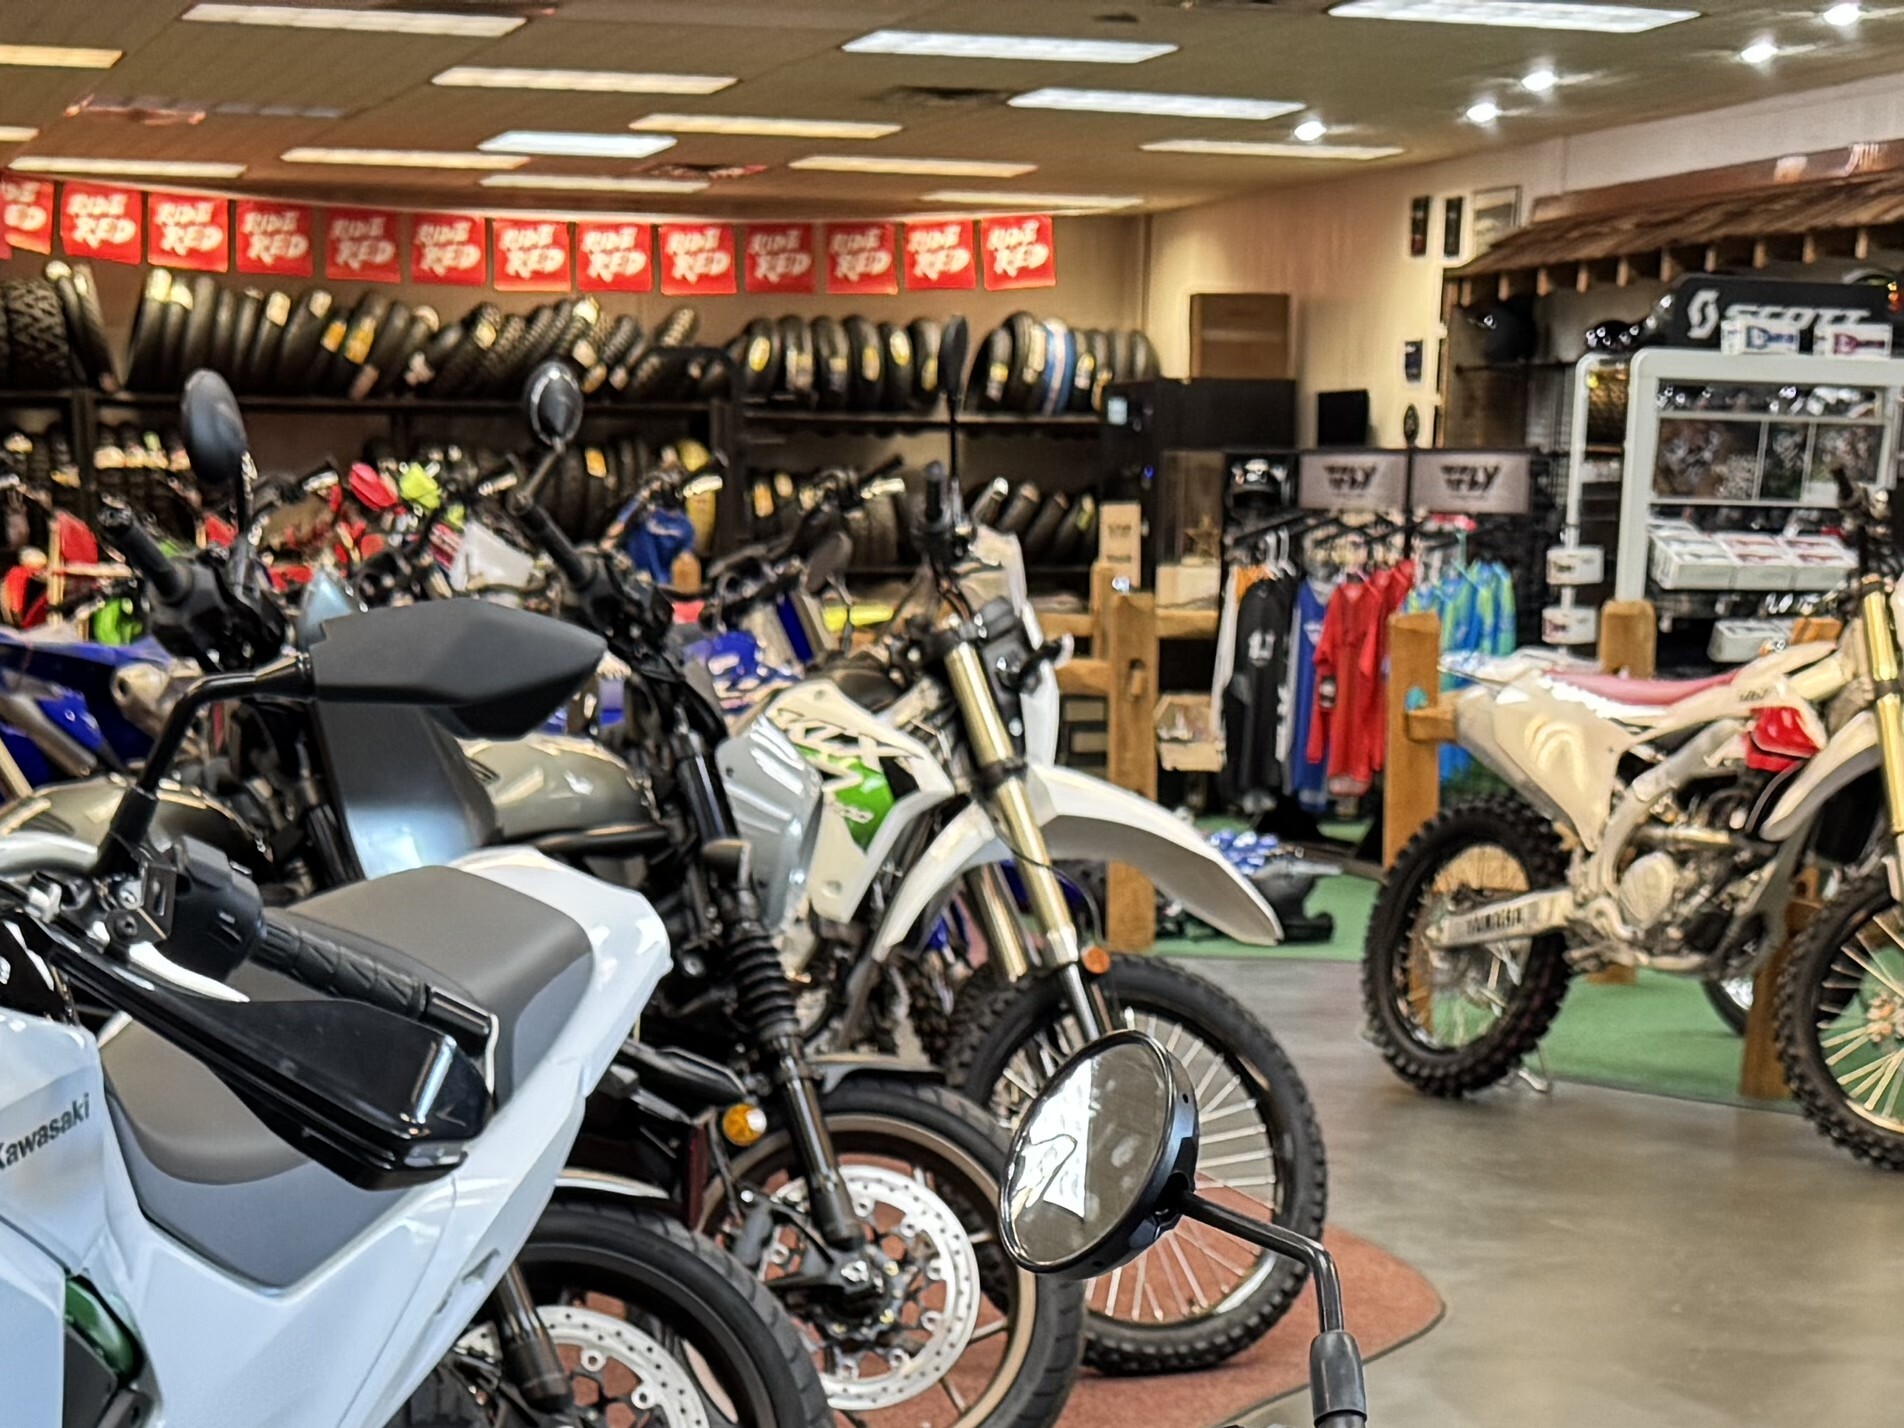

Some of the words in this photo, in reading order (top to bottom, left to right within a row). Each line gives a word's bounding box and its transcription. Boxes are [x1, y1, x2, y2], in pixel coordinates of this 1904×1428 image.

[67, 194, 128, 217] RIDE
[154, 201, 215, 226] RIDE
[72, 216, 137, 249] RED
[242, 210, 300, 235] RIDE
[329, 216, 387, 240] RIDE
[415, 220, 473, 245] RIDE
[500, 224, 556, 251] RIDE
[907, 223, 962, 253] RIDE
[986, 219, 1040, 251] RIDE
[159, 224, 224, 257] RED
[247, 232, 310, 266] RED
[335, 239, 396, 272] RED
[583, 226, 638, 253] RIDE
[667, 227, 722, 255] RIDE
[750, 228, 803, 255] RIDE
[831, 226, 884, 254] RIDE
[419, 243, 482, 277] RED
[505, 246, 566, 280] RED
[587, 249, 647, 284] RED
[671, 250, 731, 285] RED
[754, 251, 813, 284] RED
[834, 249, 893, 283] RED
[913, 247, 971, 281] RED
[993, 242, 1050, 278] RED
[1724, 304, 1872, 330] SCOTT
